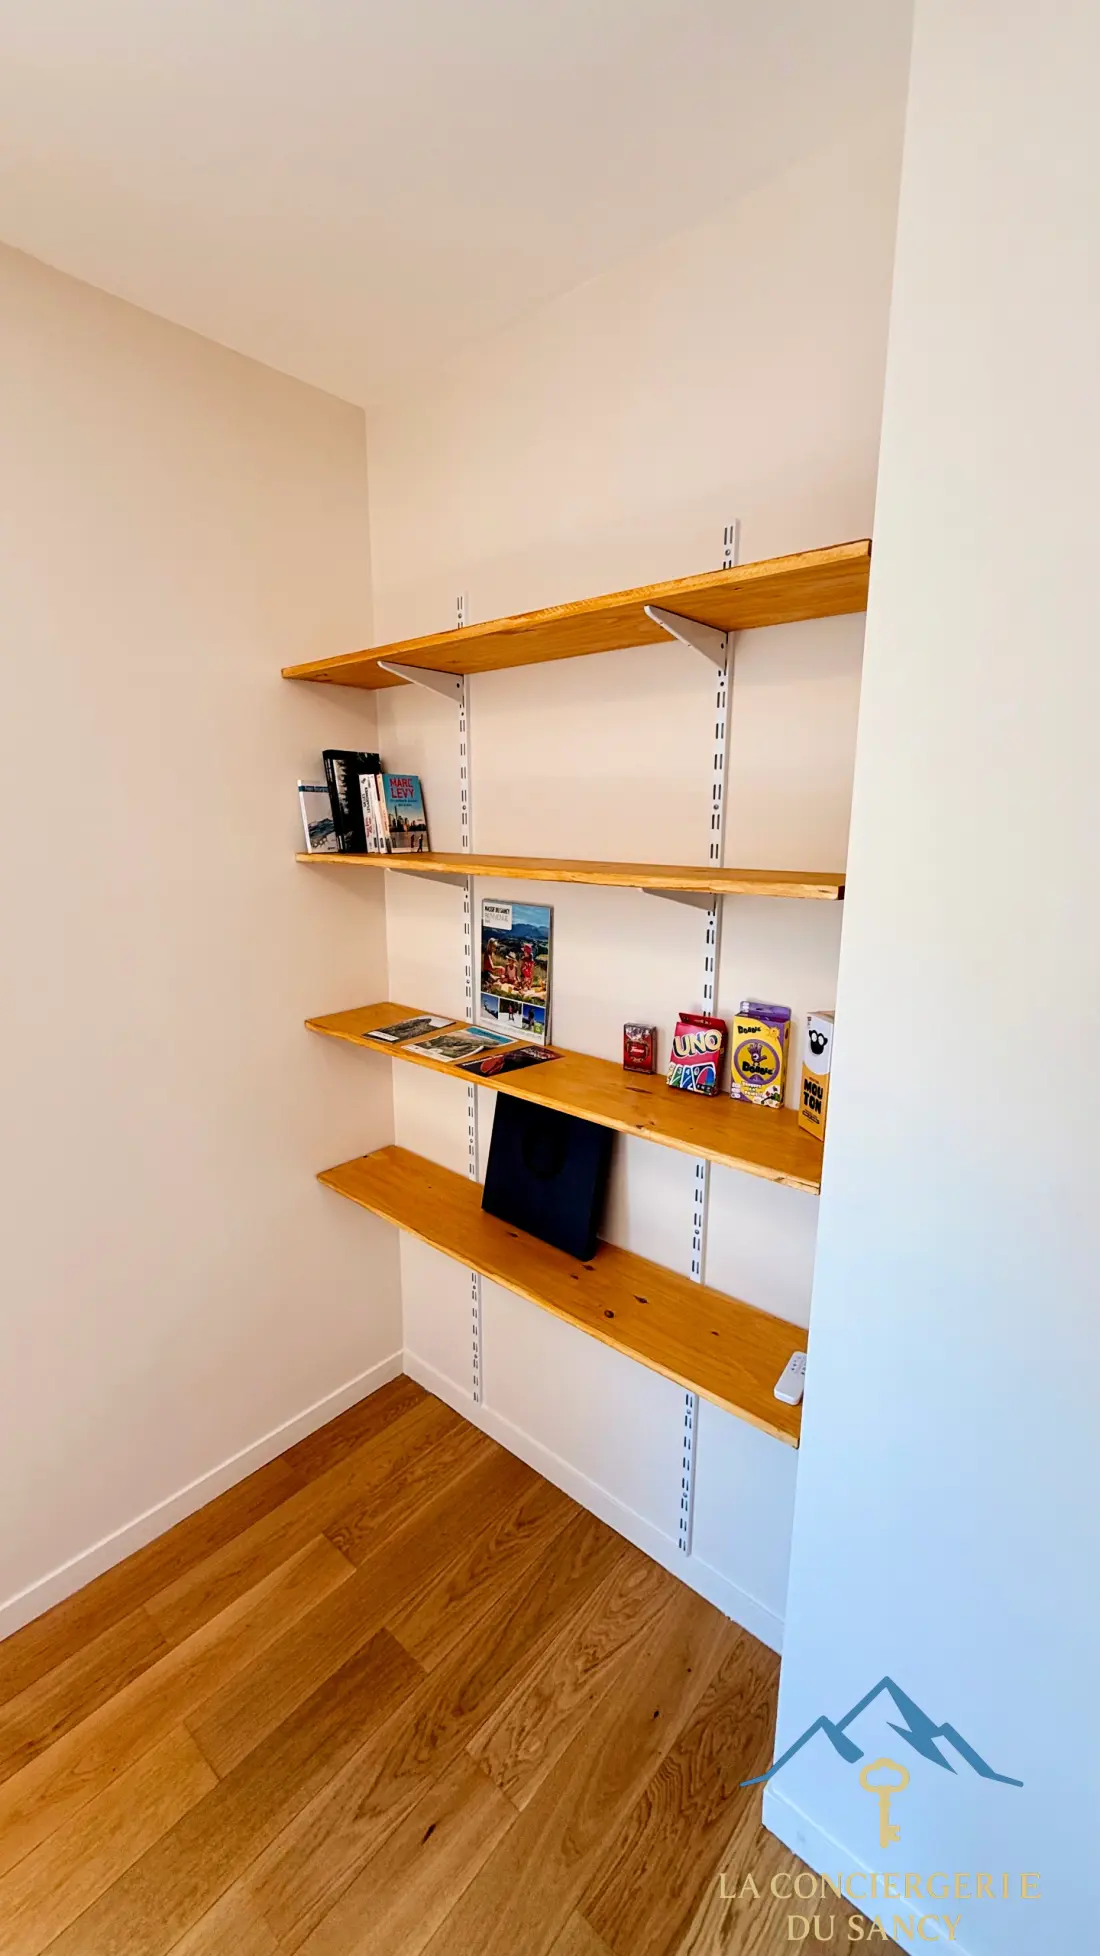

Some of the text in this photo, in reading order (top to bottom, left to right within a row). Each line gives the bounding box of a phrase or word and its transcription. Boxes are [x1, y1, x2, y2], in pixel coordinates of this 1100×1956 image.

[390, 778, 413, 788] MARC
[391, 788, 414, 799] LEVY
[673, 1029, 722, 1057] UNO
[804, 1078, 823, 1098] MOU
[803, 1091, 822, 1114] TON
